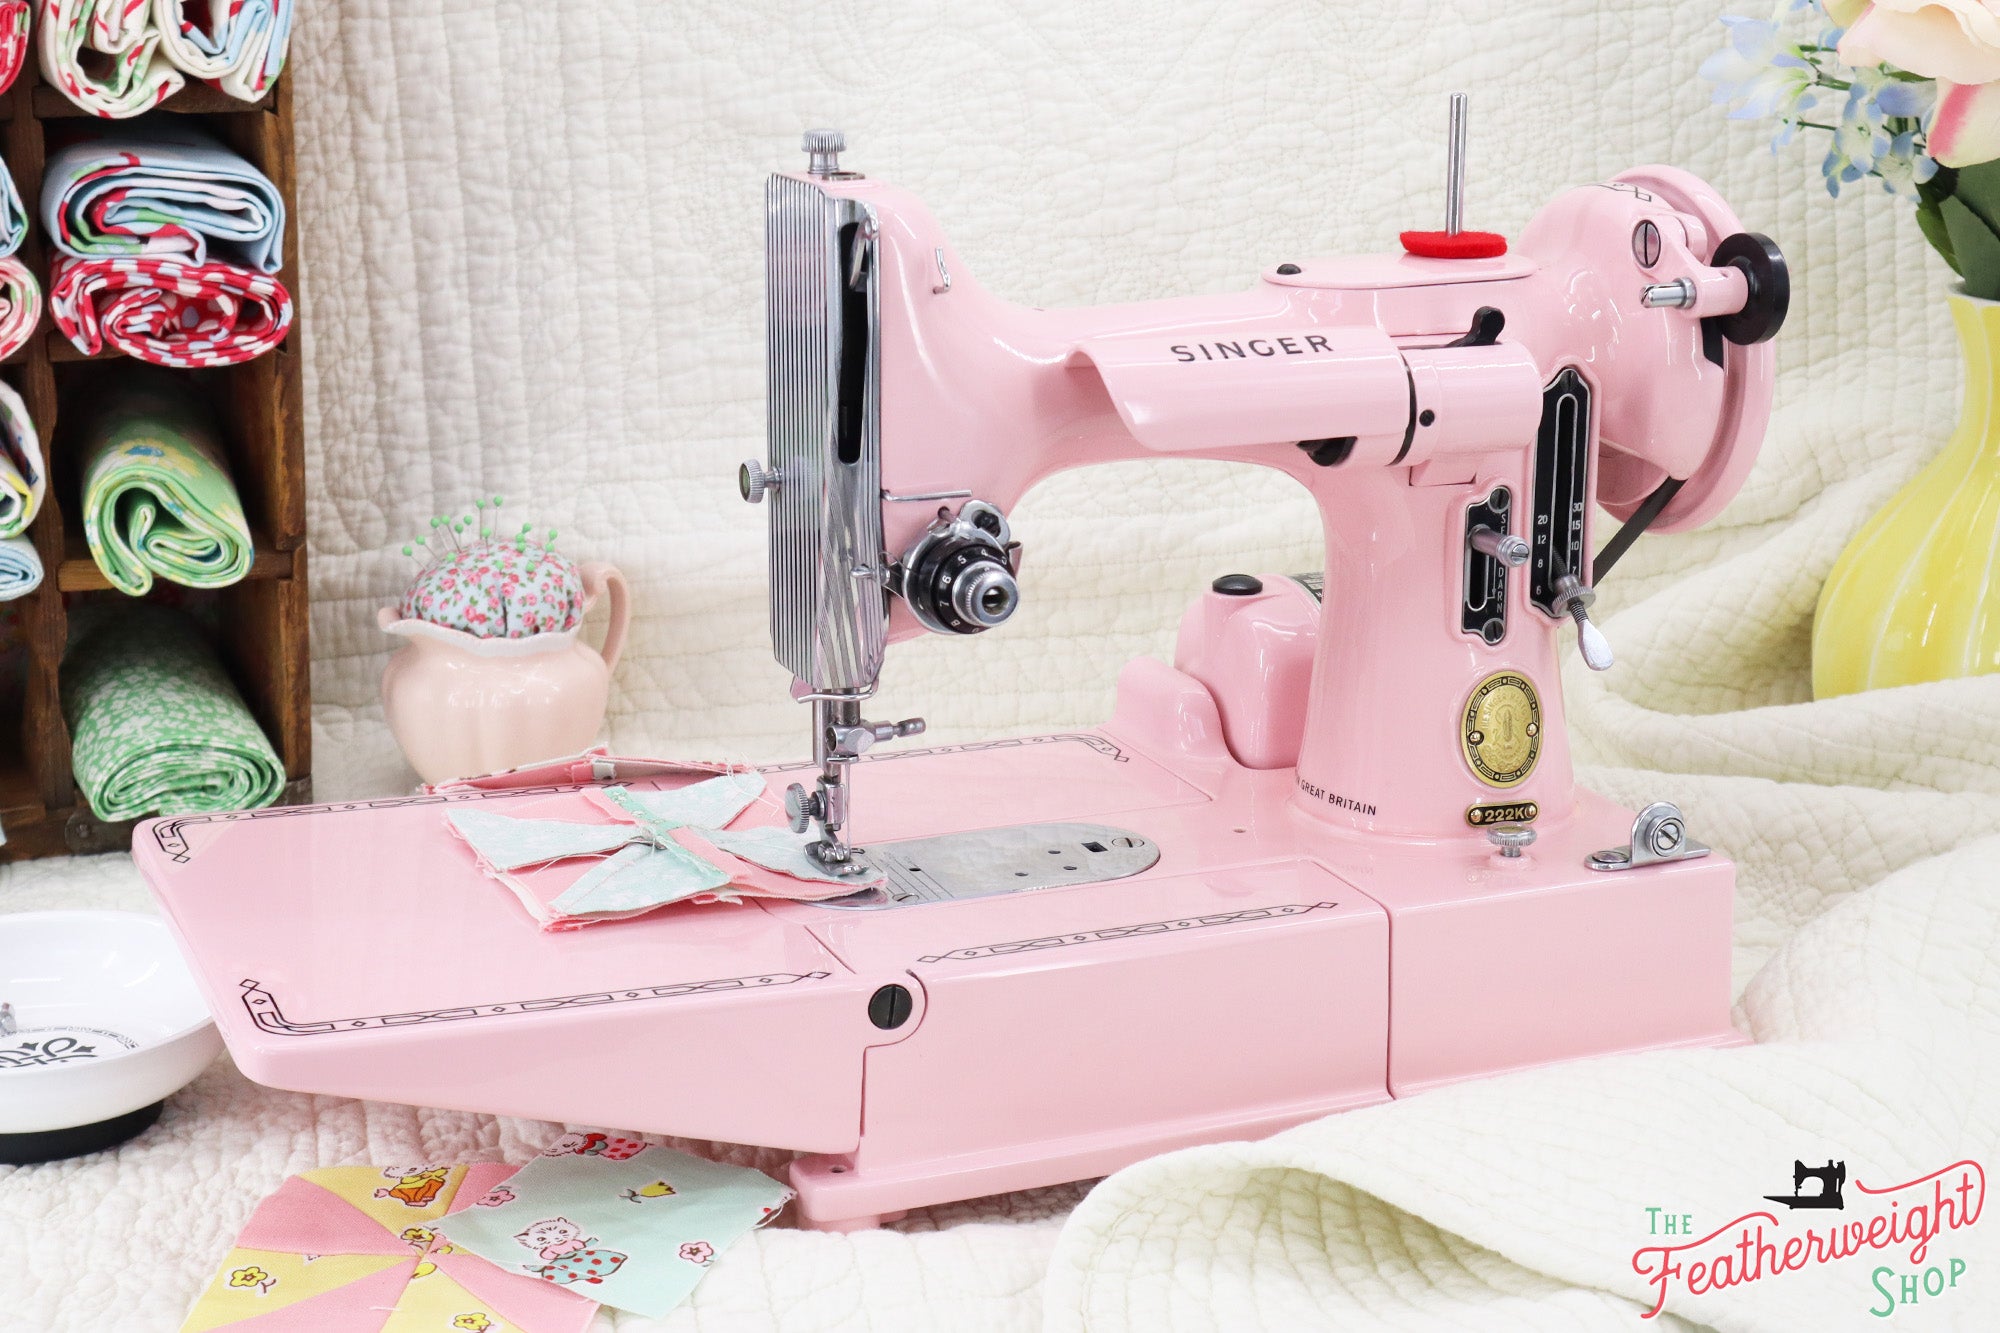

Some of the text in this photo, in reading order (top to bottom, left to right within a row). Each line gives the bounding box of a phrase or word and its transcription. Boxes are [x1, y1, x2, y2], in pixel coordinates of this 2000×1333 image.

[1170, 335, 1334, 362] SINGER
[1572, 502, 1582, 512] 30
[1537, 514, 1549, 525] 20
[1571, 520, 1581, 530] 15
[1537, 535, 1547, 545] 12
[1570, 541, 1580, 551] 10
[957, 555, 966, 564] 5
[1537, 558, 1544, 568] 8
[942, 575, 951, 583] 6
[1496, 567, 1505, 613] DARN
[1536, 585, 1541, 595] 6
[1300, 779, 1326, 800] GREAT
[1328, 793, 1377, 816] BRITAIN
[1484, 807, 1525, 822] 222K
